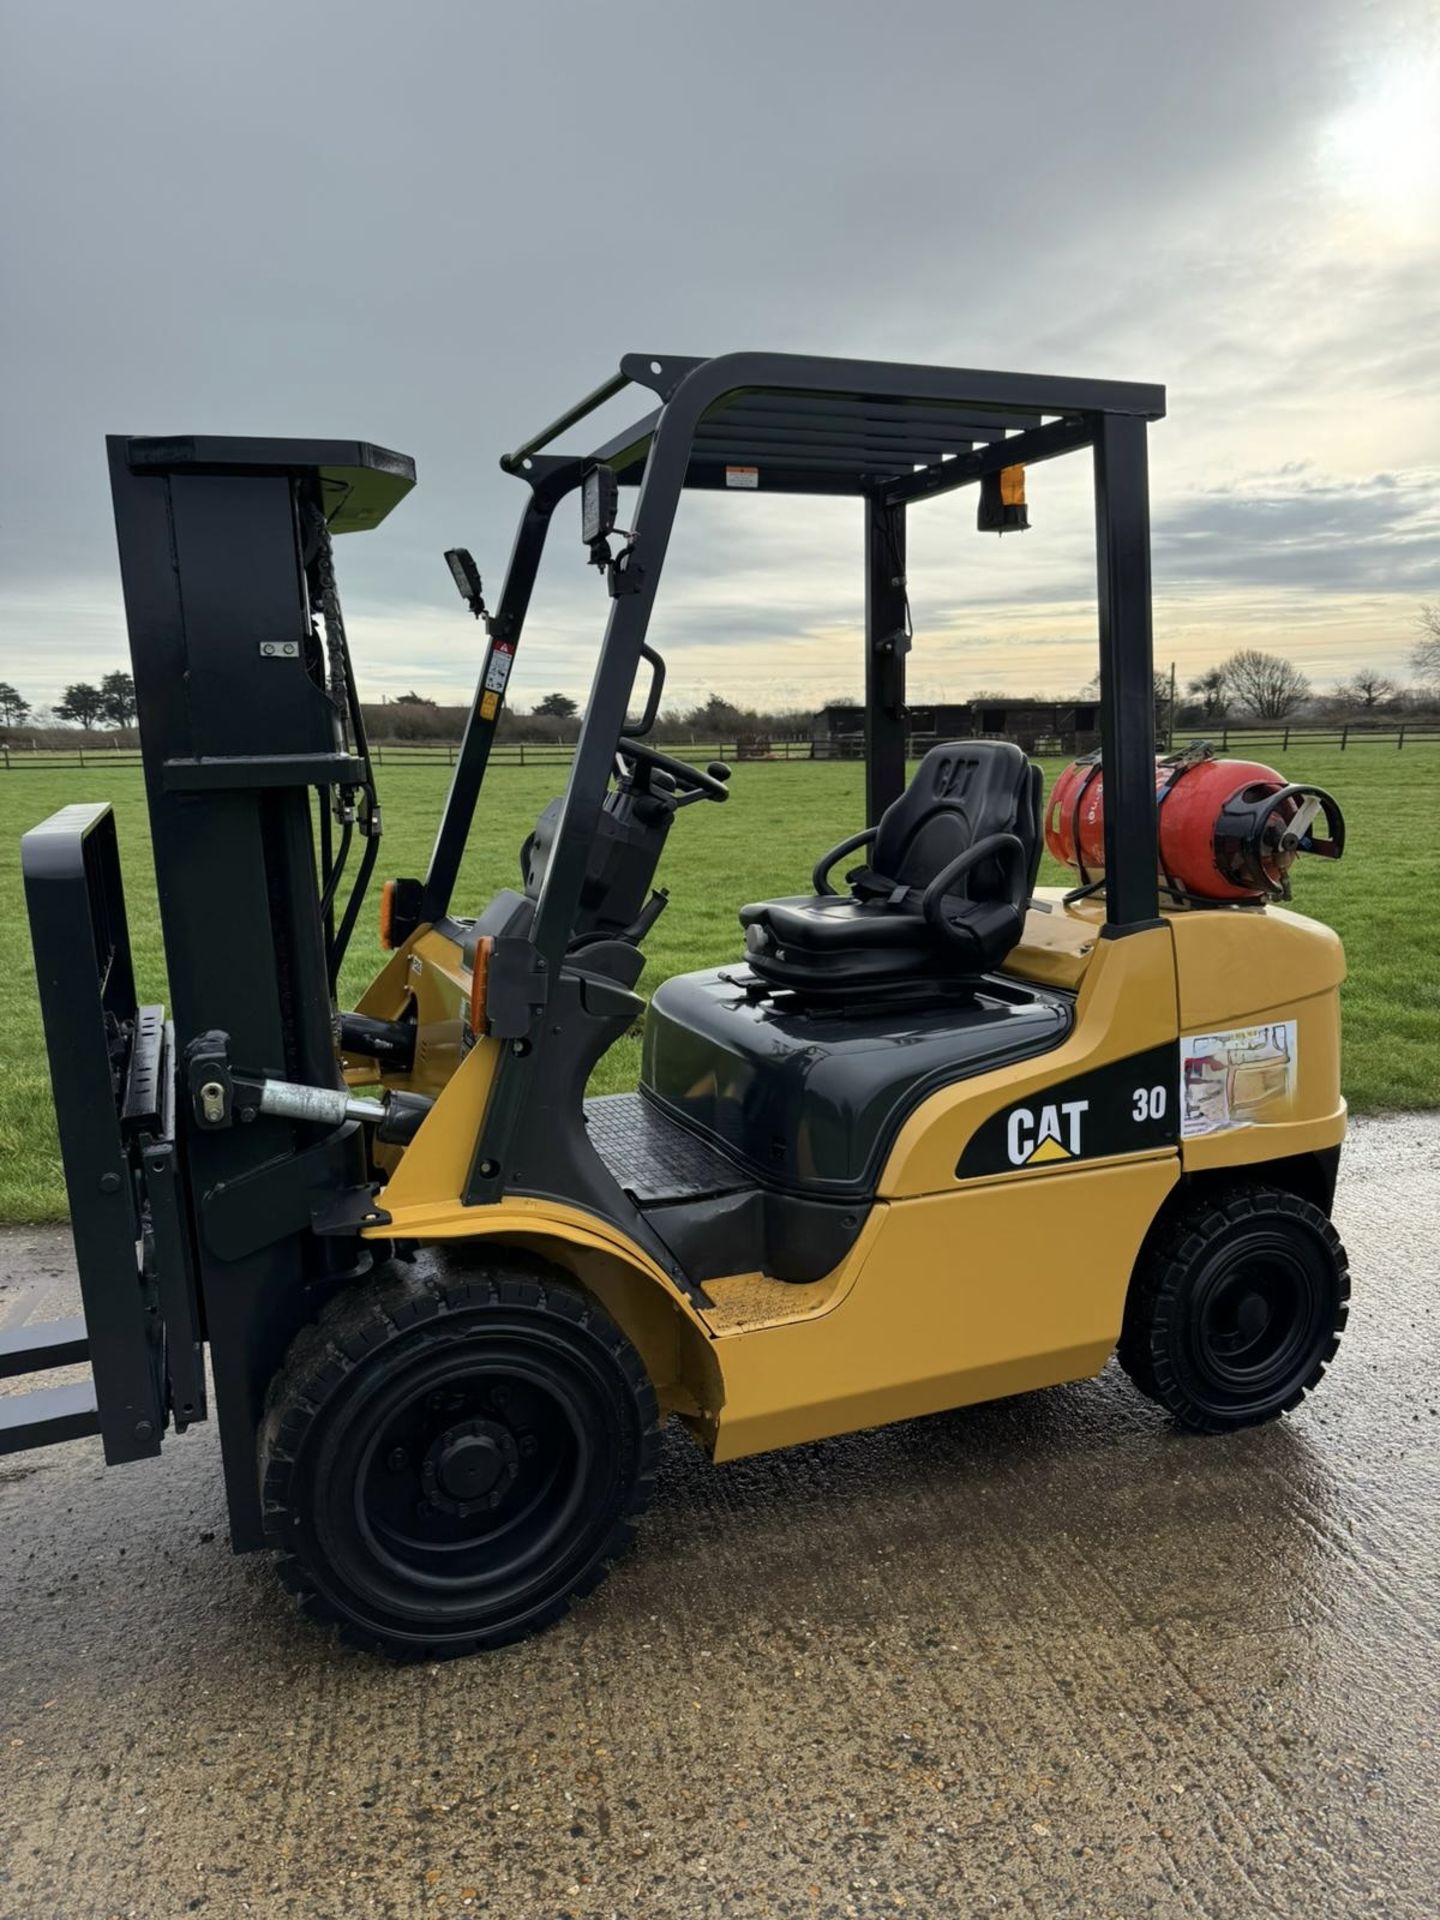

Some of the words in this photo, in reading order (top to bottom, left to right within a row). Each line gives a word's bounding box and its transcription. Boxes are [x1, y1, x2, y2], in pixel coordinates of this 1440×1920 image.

[932, 758, 980, 799] CAT
[1132, 1085, 1167, 1122] 30
[1007, 1100, 1089, 1166] CAT
